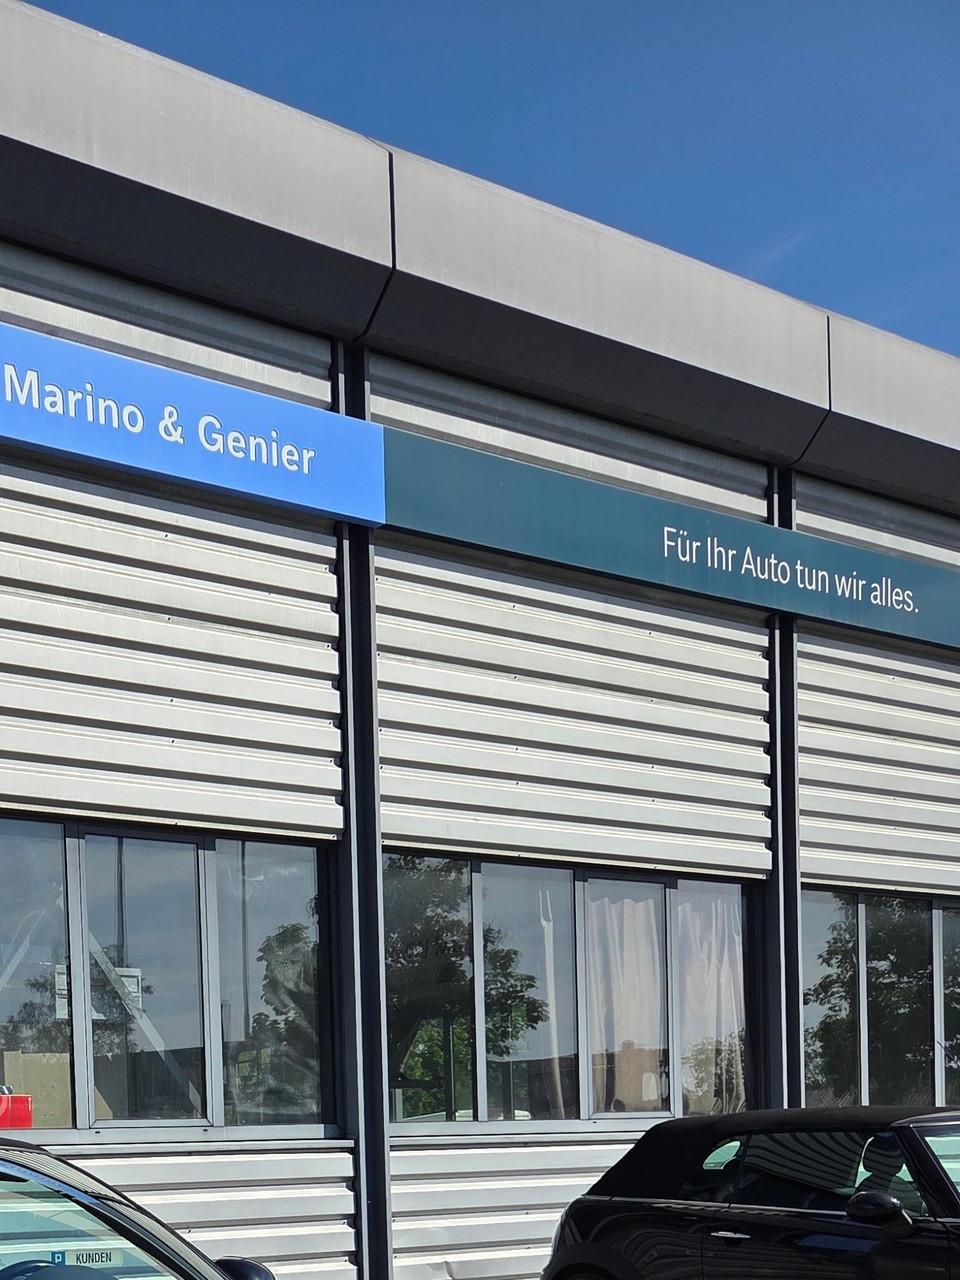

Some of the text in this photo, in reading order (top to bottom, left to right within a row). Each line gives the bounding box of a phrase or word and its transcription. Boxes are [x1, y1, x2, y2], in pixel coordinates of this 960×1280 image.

[3, 362, 144, 433] Marino
[158, 404, 185, 444] &
[197, 414, 316, 475] Genier
[663, 526, 919, 613] Für Ihr Auto tun wir alles.
[54, 1252, 112, 1264] P KUNDEN
